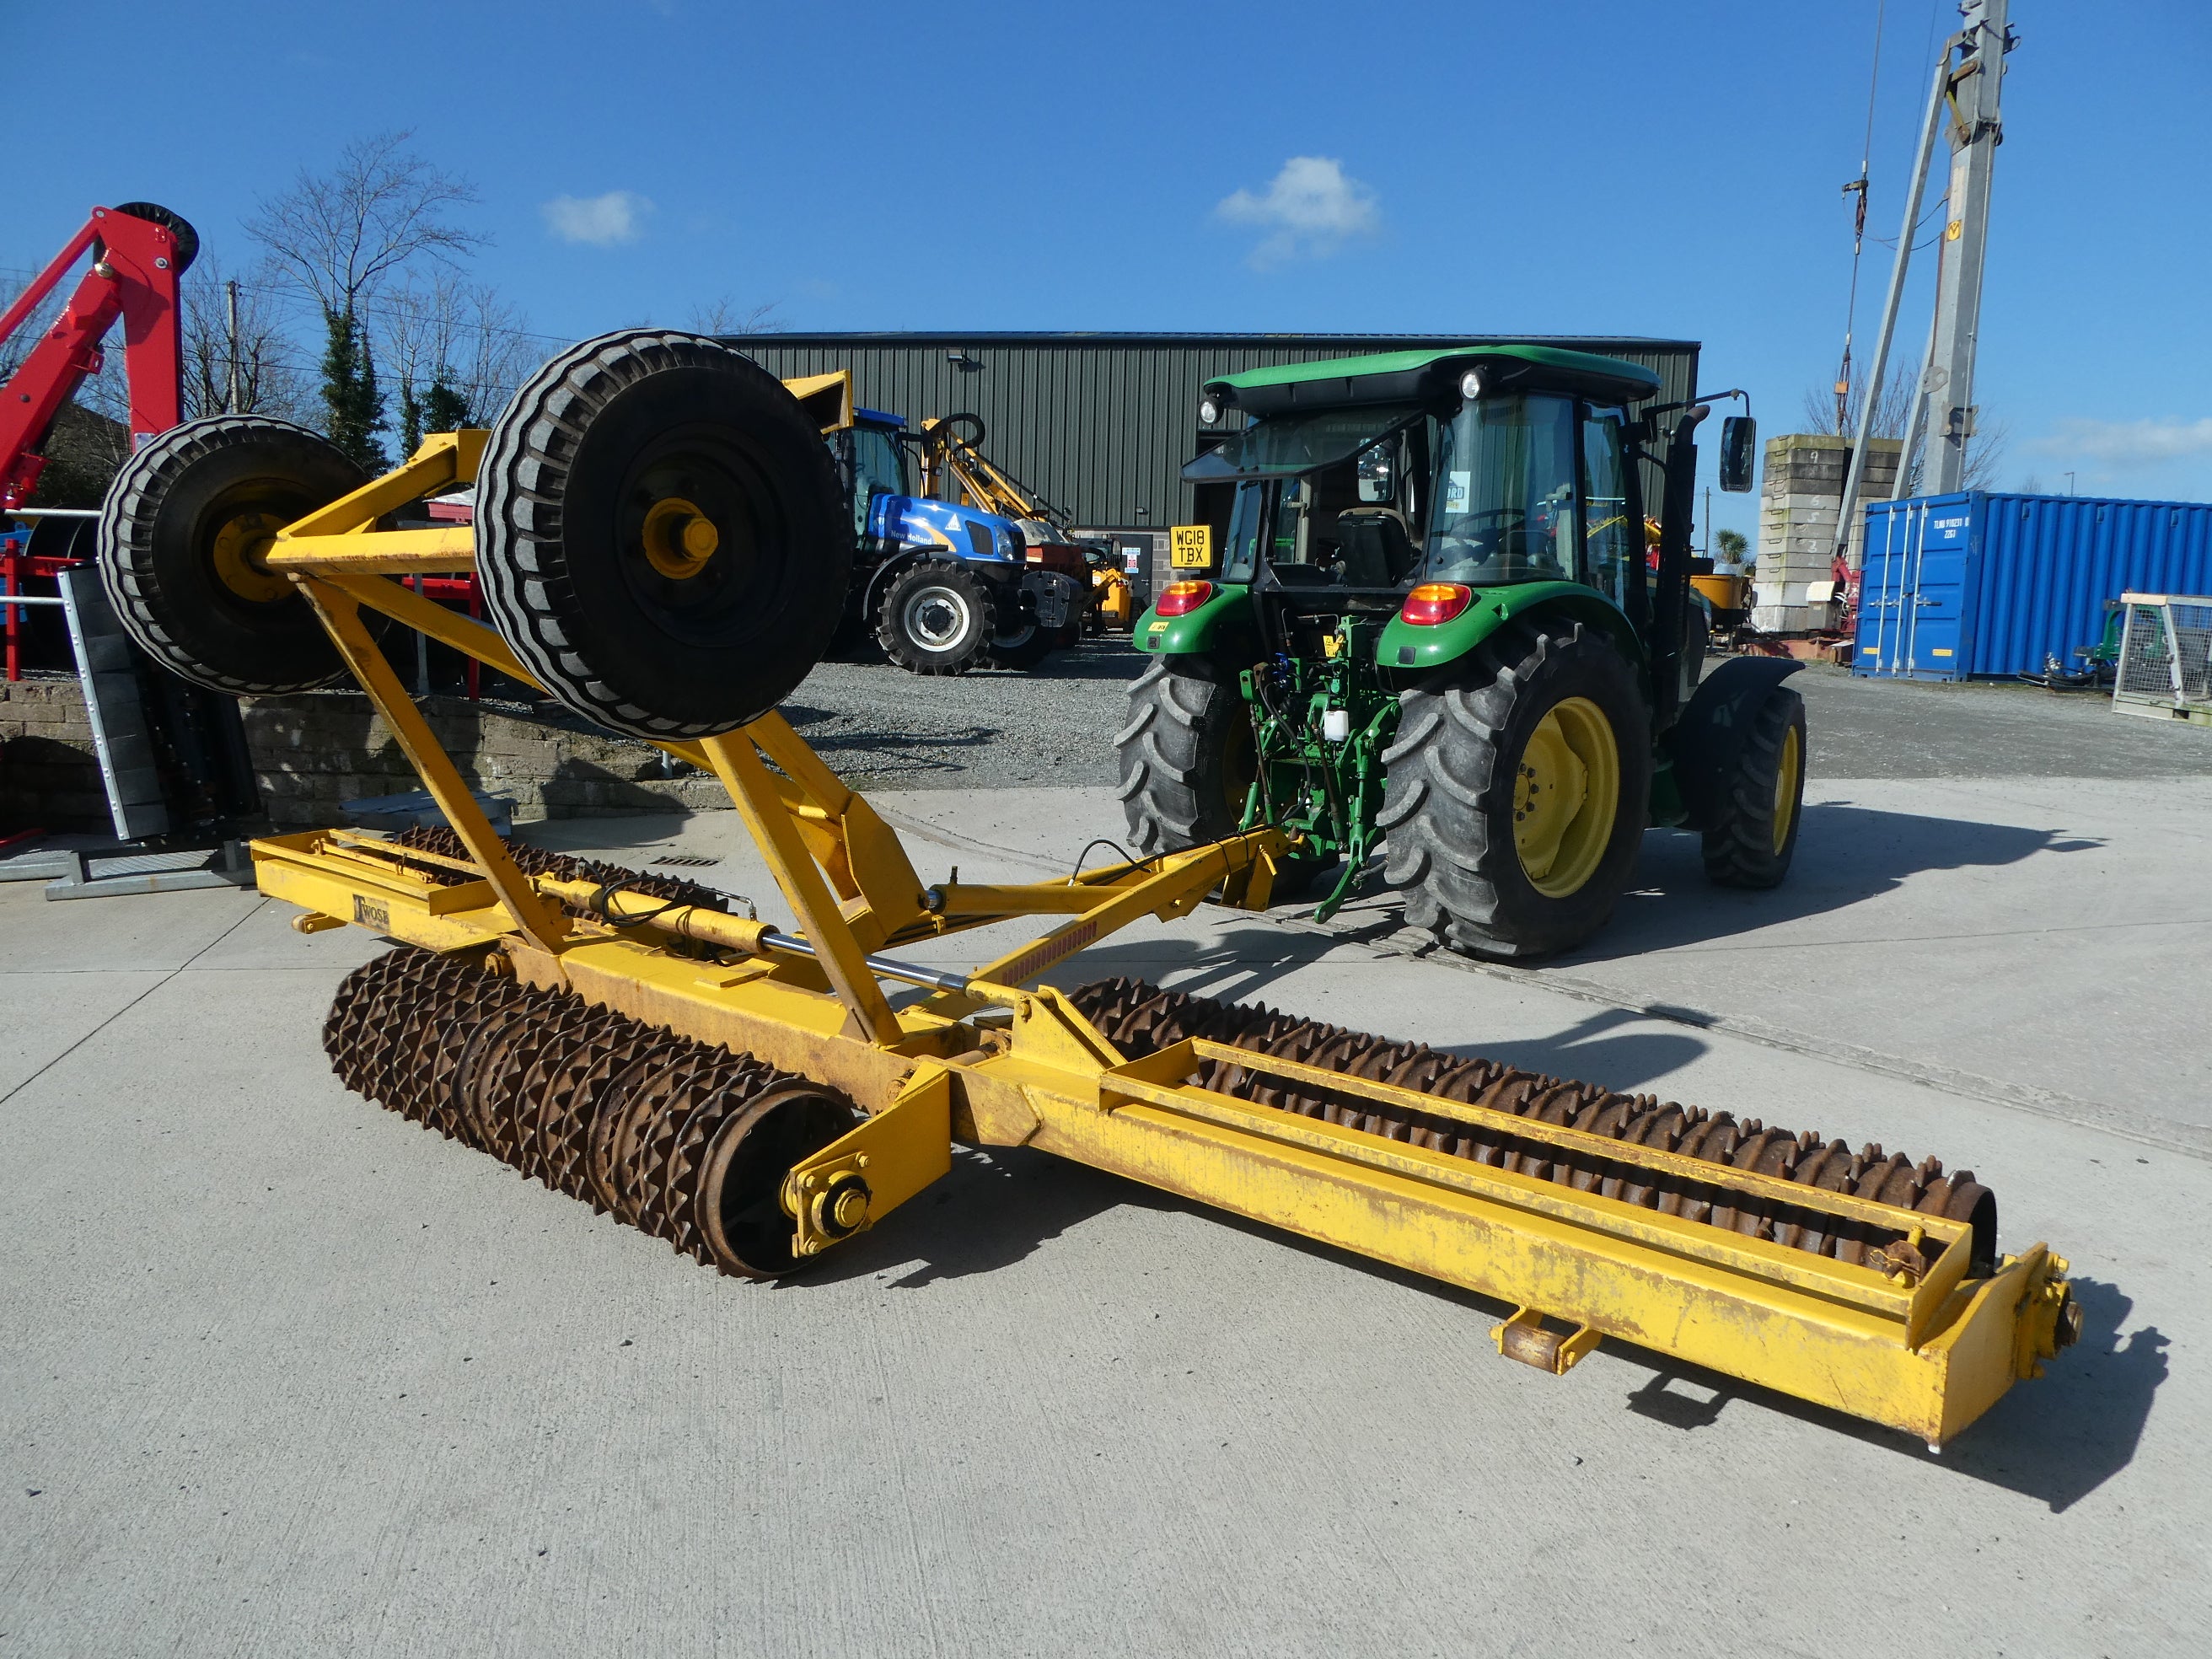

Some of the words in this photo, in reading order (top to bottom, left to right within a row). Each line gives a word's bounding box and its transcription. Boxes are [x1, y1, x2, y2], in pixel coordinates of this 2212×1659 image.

[907, 533, 932, 545] Holland
[1176, 530, 1205, 545] WG18
[1178, 548, 1203, 562] TBX
